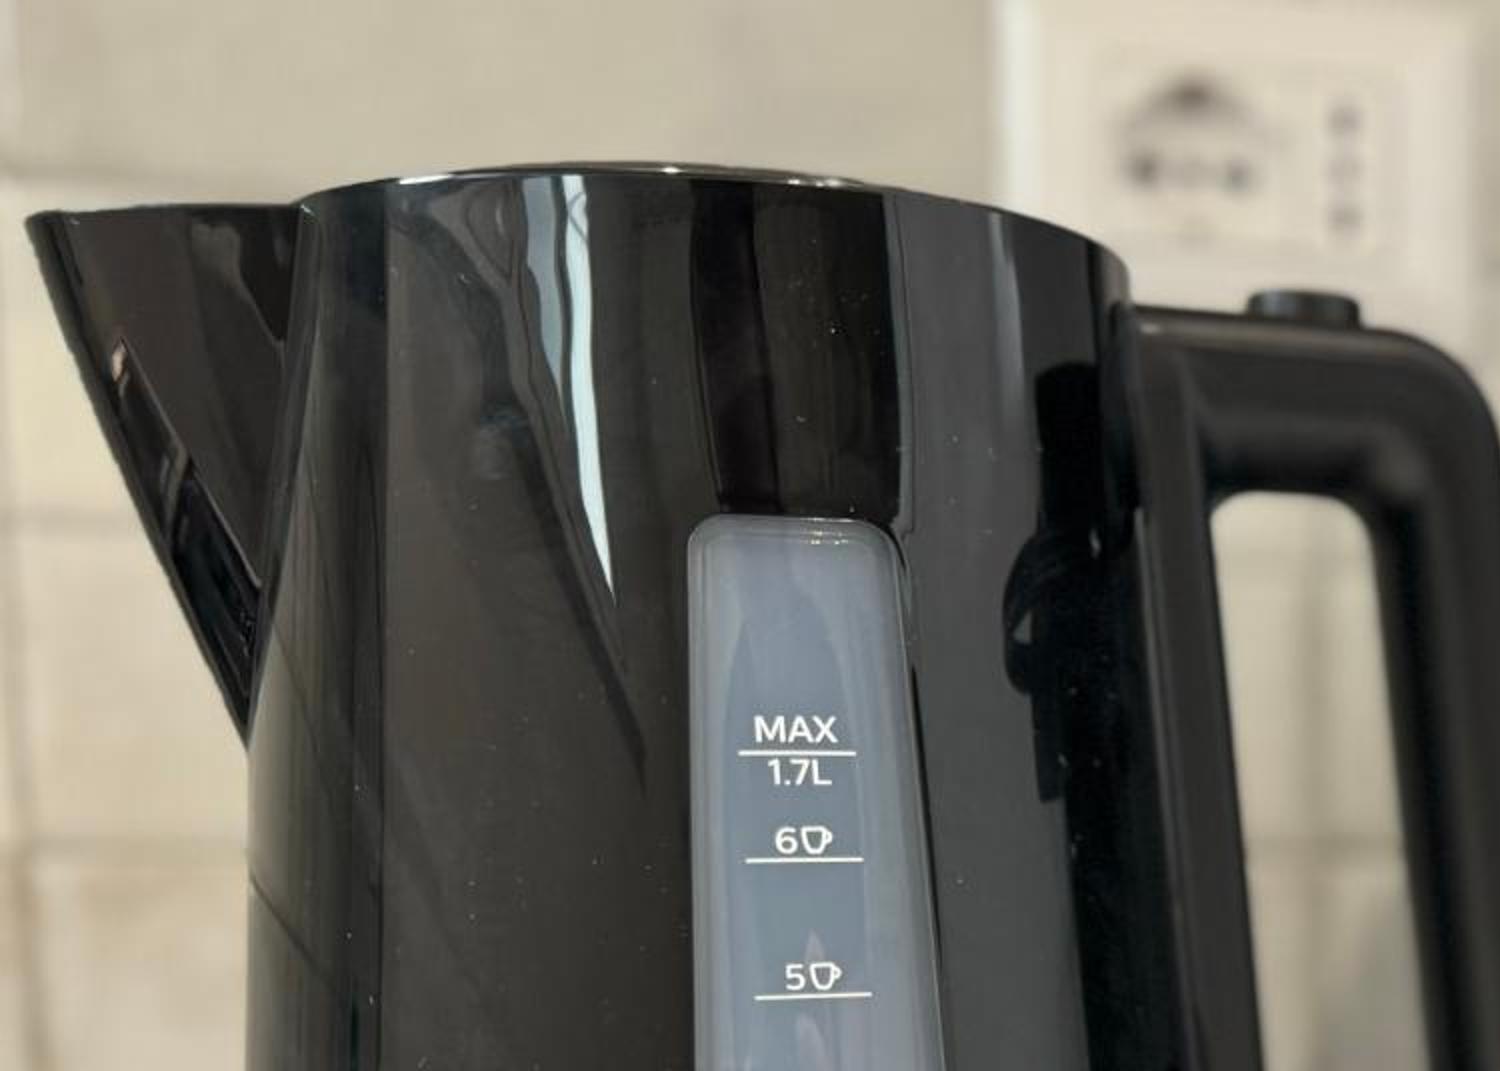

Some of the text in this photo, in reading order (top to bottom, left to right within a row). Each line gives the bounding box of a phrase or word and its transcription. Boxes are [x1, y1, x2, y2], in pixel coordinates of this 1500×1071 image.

[754, 715, 839, 744] MAX
[767, 758, 833, 786] 1.7L
[774, 826, 798, 855] 6
[785, 963, 806, 991] 5
